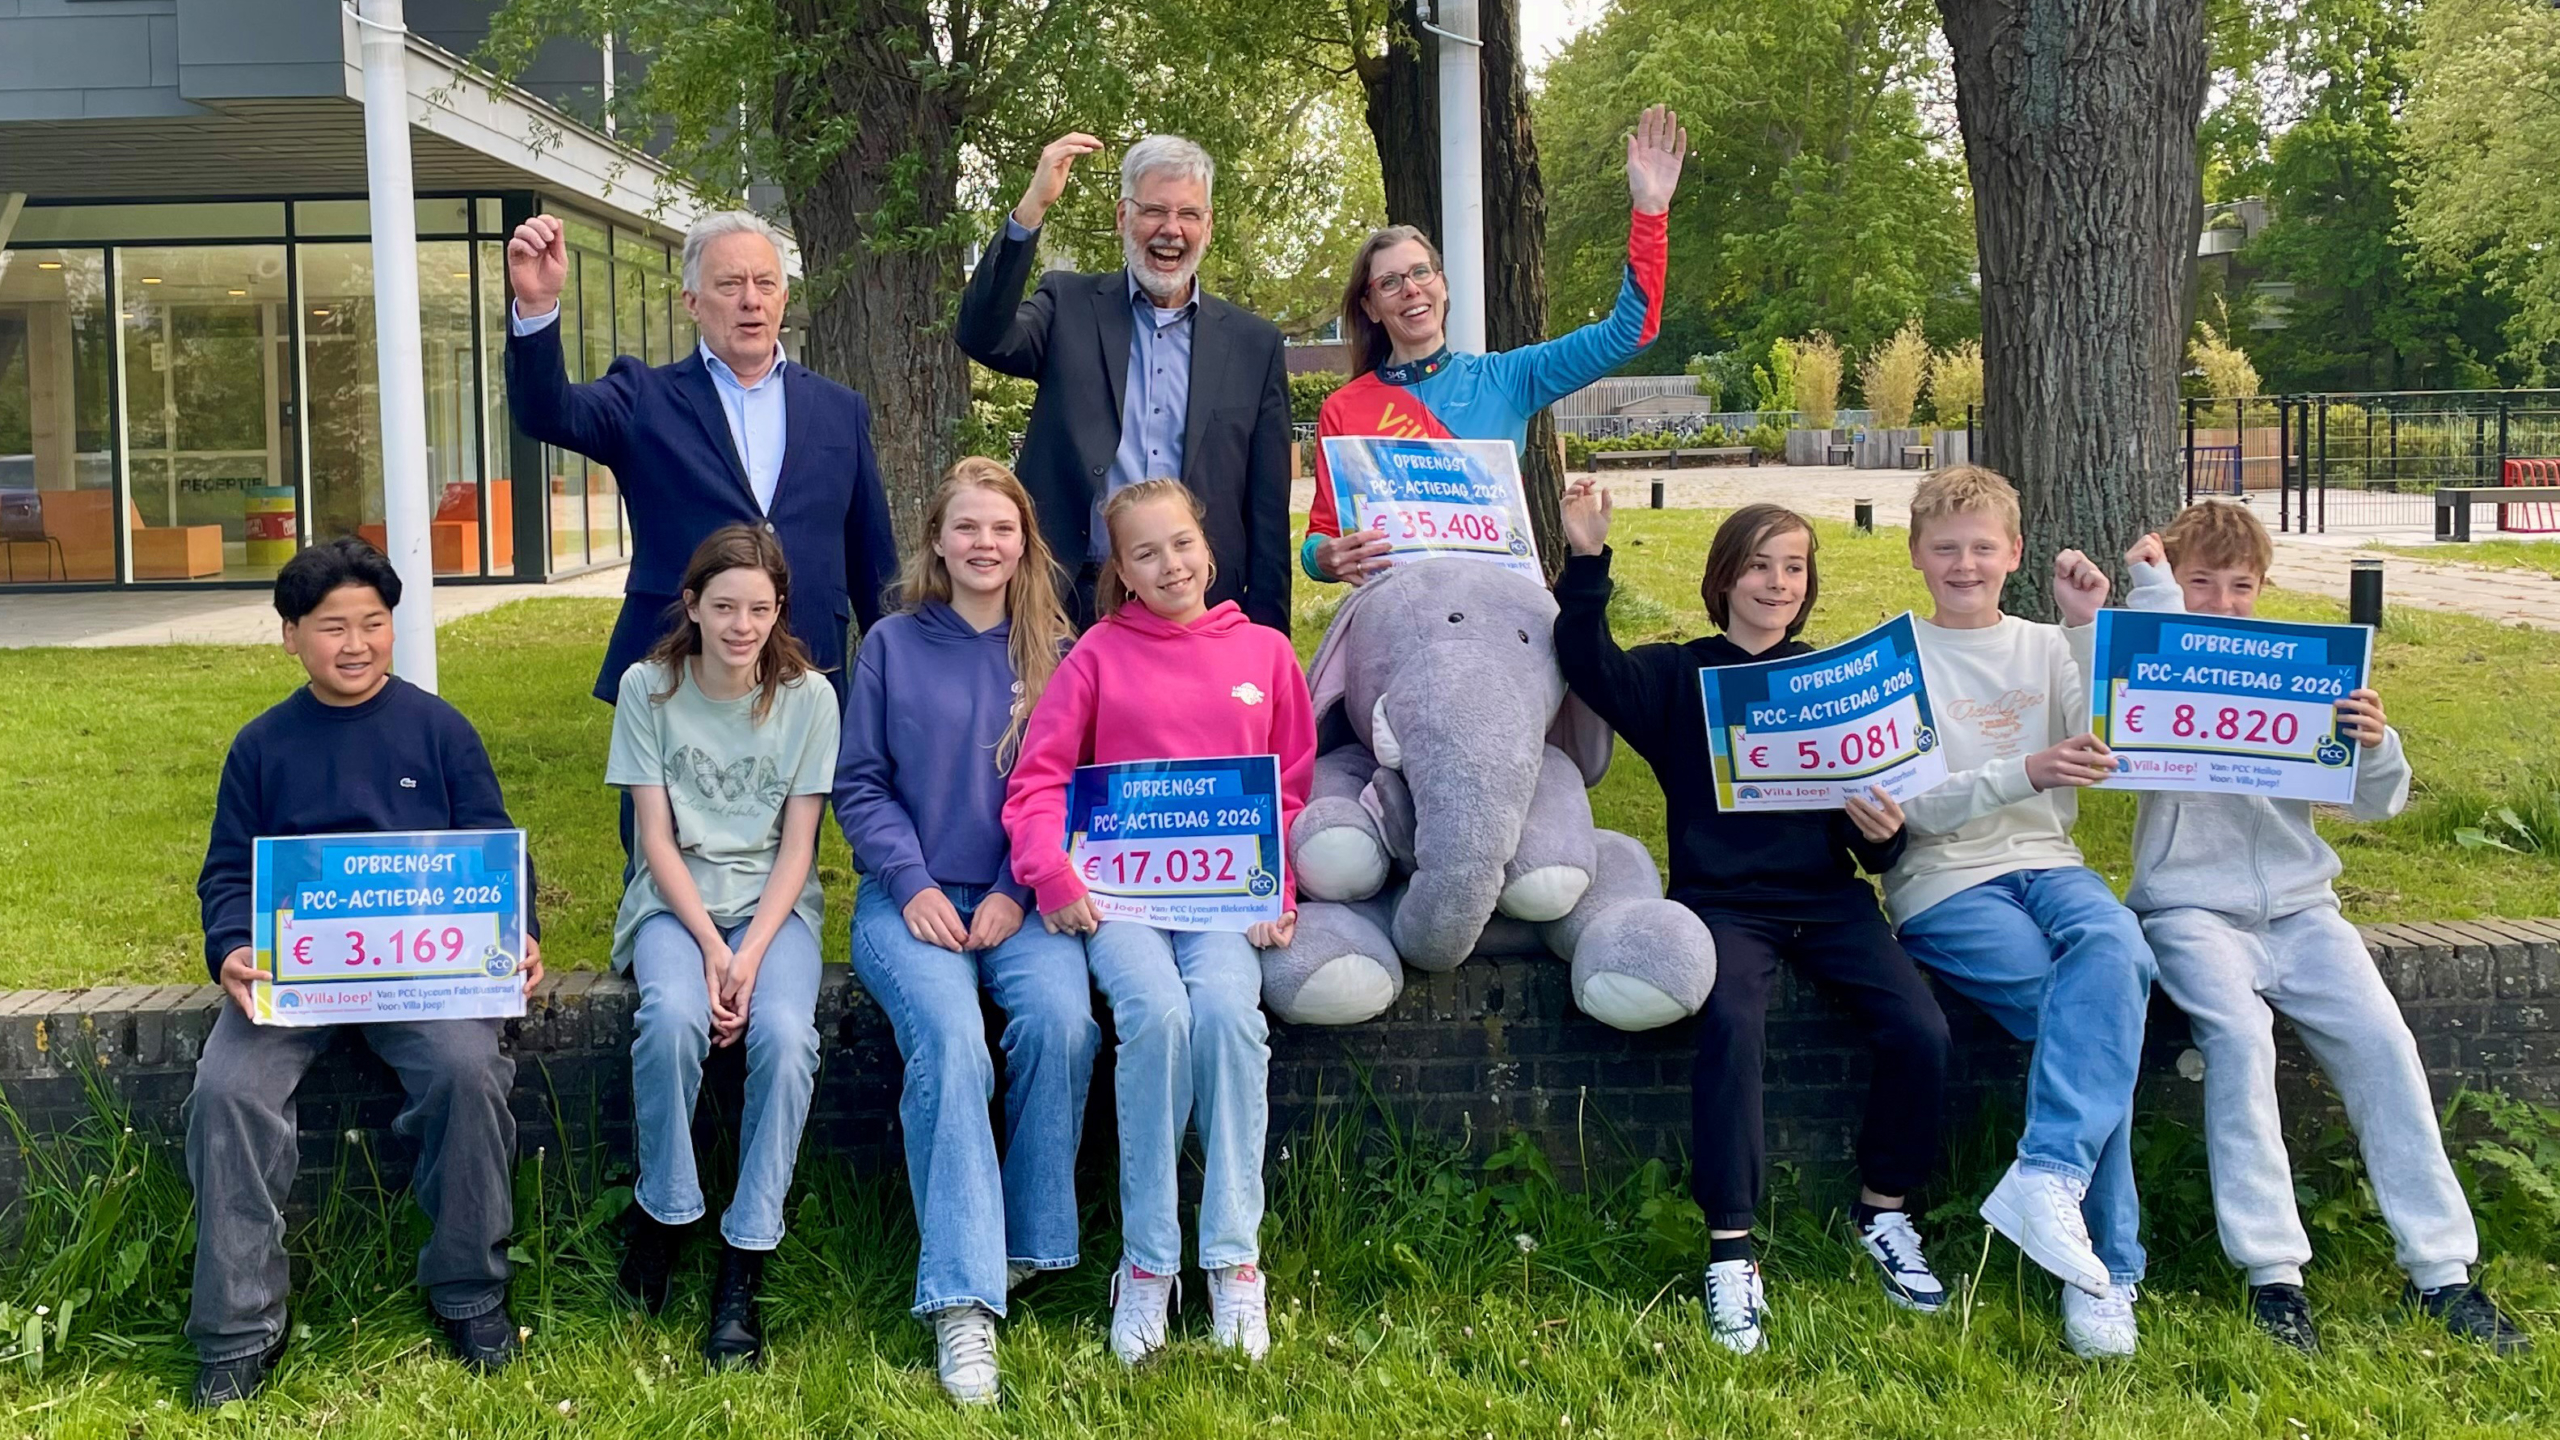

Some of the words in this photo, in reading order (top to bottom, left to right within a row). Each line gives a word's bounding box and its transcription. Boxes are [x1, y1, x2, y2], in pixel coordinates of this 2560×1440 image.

[1393, 453, 1468, 472] OPBRENGST
[1369, 480, 1469, 498] PCC-ACTIEDAG
[1473, 484, 1507, 500] 2026
[1372, 514, 1391, 539] €
[1397, 511, 1500, 542] 35.408
[2180, 632, 2299, 661] OPBRENGST
[1789, 649, 1879, 694] OPBRENGST
[2136, 662, 2283, 691] PCC-ACTIEDAG
[2290, 674, 2343, 697] 2026
[1752, 685, 1880, 727] PCC-ACTIEDAG
[1882, 667, 1914, 697] 2026
[2125, 705, 2146, 733] €
[2172, 704, 2299, 745] 8.820
[1748, 746, 1770, 769] €
[1797, 717, 1900, 770] 5.081
[1918, 733, 1932, 748] PCC
[2320, 748, 2344, 760] PCC
[2133, 760, 2160, 772] Villa
[2163, 761, 2198, 775] Joep!
[2210, 762, 2230, 771] Van:
[2232, 763, 2251, 773] PCC
[1122, 777, 1217, 799] OPBRENGST
[2209, 773, 2233, 783] Voor:
[2235, 775, 2254, 785] Villa
[2254, 777, 2280, 790] Joep!
[1763, 787, 1792, 797] Villa
[1796, 786, 1831, 797] Joep!
[1093, 809, 1211, 833] PCC-ACTIEDAG
[1216, 807, 1262, 827] 2026
[343, 853, 456, 875] OPBRENGST
[1082, 856, 1102, 881] €
[1112, 847, 1236, 884] 17.032
[1251, 879, 1271, 890] PCC
[301, 887, 446, 911] PCC-ACTIEDAG
[452, 885, 502, 906] 2026
[1113, 901, 1147, 914] Joep!
[1149, 913, 1171, 922] Voor:
[1173, 914, 1190, 923] Villa
[1190, 915, 1213, 925] Joep!
[1150, 904, 1169, 913] Van:
[1170, 904, 1188, 913] PCC
[1189, 904, 1219, 915] Lyceum
[292, 936, 314, 966] €
[344, 927, 465, 966] 3.169
[488, 959, 510, 970] PCC
[304, 992, 335, 1004] Villa
[338, 990, 373, 1005] Joep!
[376, 989, 396, 998] Van:
[398, 988, 417, 998] PCC
[419, 987, 452, 998] Lyceum
[376, 1002, 401, 1011] Voor:
[402, 1001, 421, 1010] Villa
[421, 999, 446, 1012] Joep!
